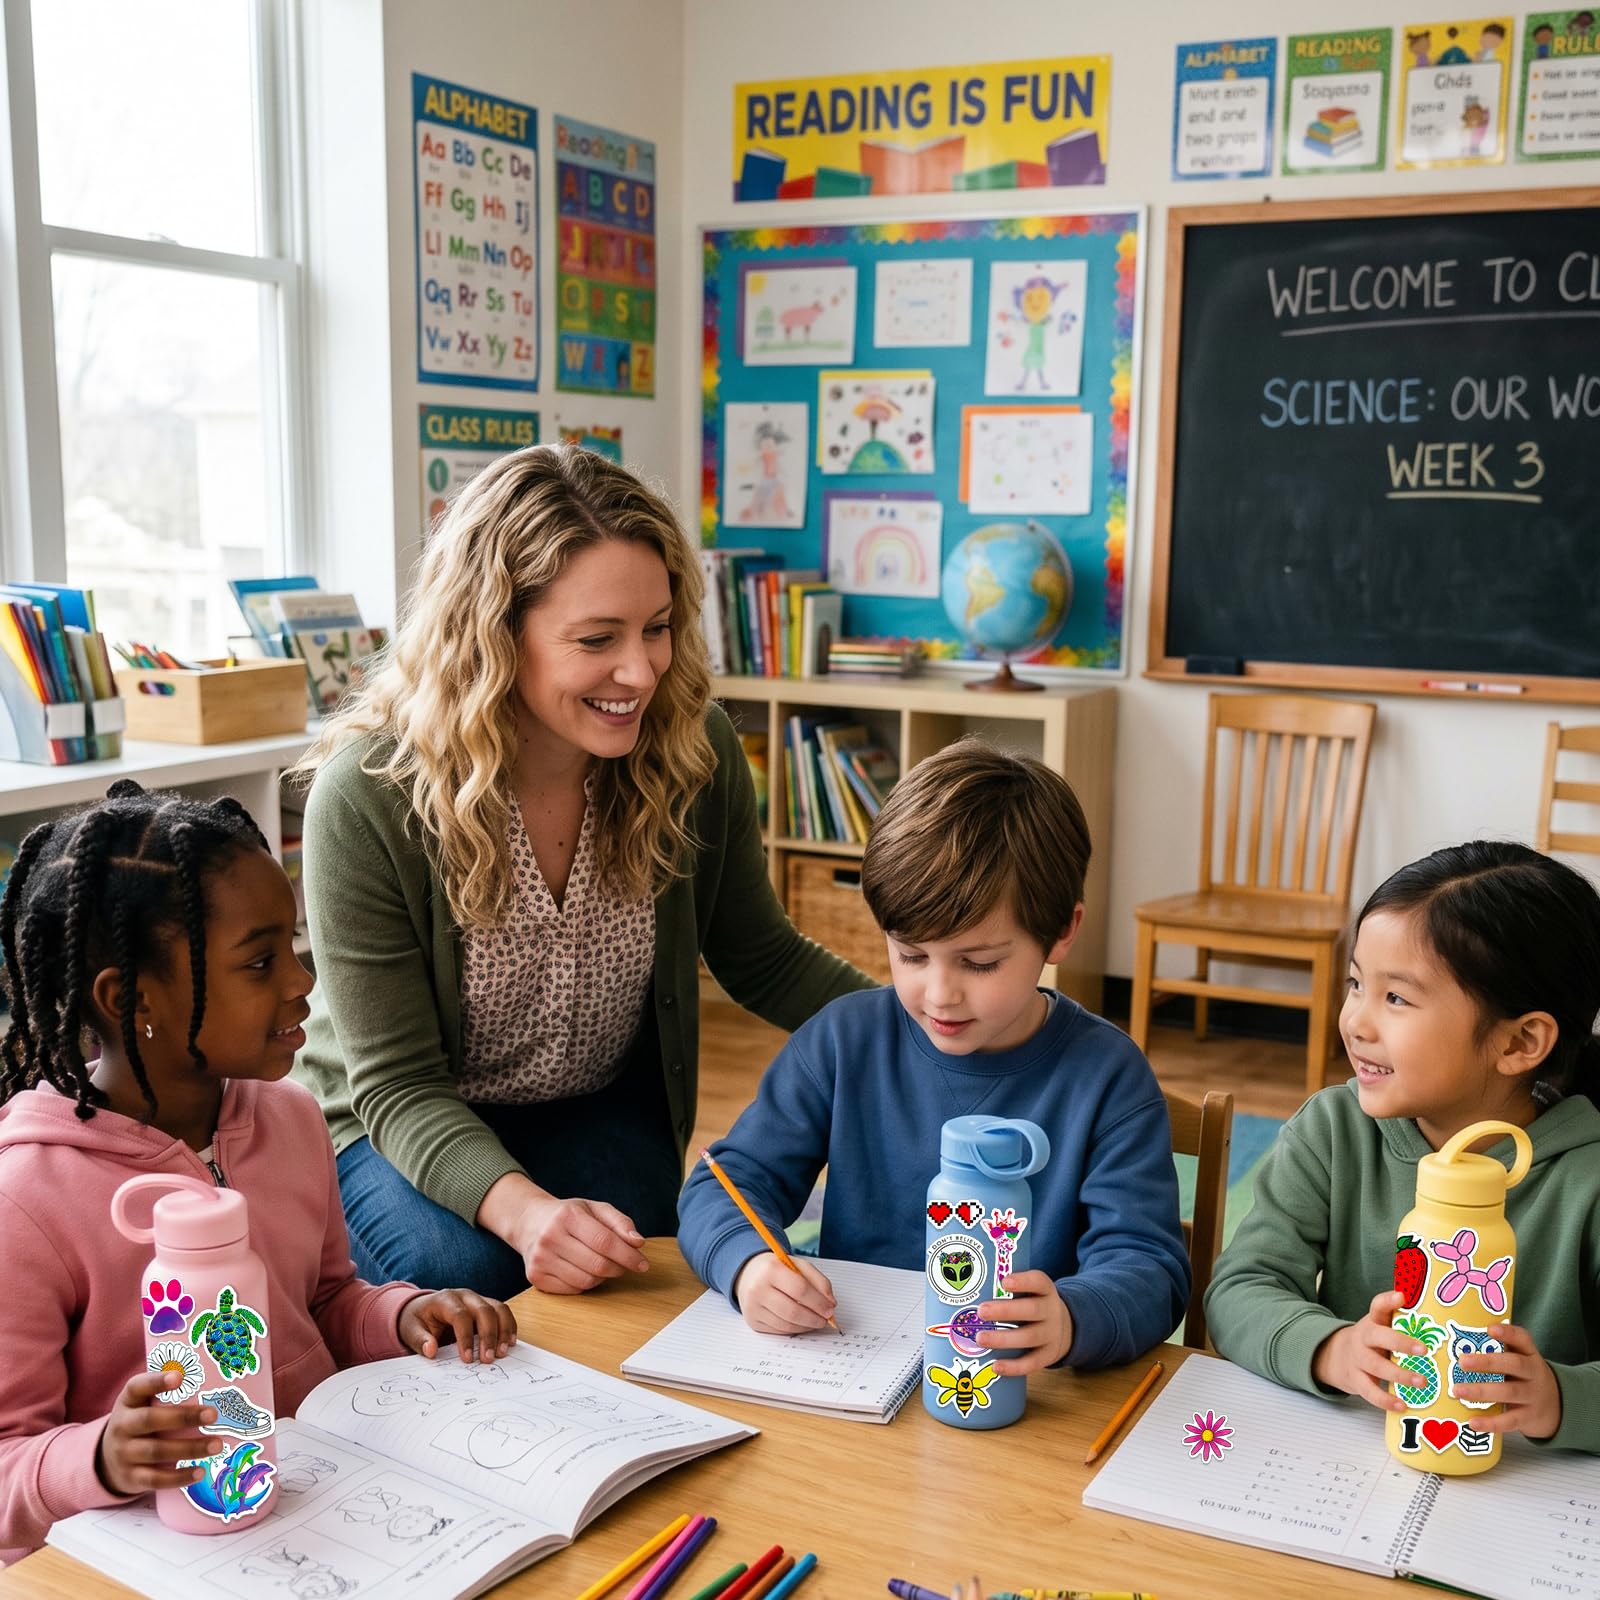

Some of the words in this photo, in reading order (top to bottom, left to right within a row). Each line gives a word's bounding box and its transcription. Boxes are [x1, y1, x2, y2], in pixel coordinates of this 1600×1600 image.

[1184, 46, 1270, 68] ALPHABET
[1296, 36, 1382, 57] READING
[424, 85, 528, 140] ALPHABET
[746, 81, 932, 140] READING
[949, 78, 986, 126] IS
[1003, 70, 1094, 123] FUN
[422, 133, 446, 160] Aa
[453, 139, 476, 167] Bb
[481, 147, 504, 175] Cc
[510, 154, 532, 181] De
[425, 181, 443, 208] Ff
[451, 187, 476, 222] Gg
[483, 194, 506, 222] Hh
[588, 174, 604, 207] B
[613, 181, 628, 214] C
[635, 184, 650, 218] D
[448, 234, 480, 262] Mm
[483, 240, 507, 267] Nn
[510, 245, 532, 273] Op
[425, 278, 452, 314] Qq
[458, 283, 478, 308] Rr
[486, 287, 505, 312] Ss
[512, 290, 532, 316] Tu
[1267, 260, 1459, 319] WELCOME
[1483, 257, 1537, 304] TO
[1558, 251, 1600, 302] CL
[614, 292, 629, 322] S
[425, 325, 451, 351] Vw
[457, 329, 480, 356] Xx
[486, 333, 508, 368] Yy
[513, 336, 532, 361] Zz
[563, 340, 587, 371] W
[1260, 377, 1436, 428] SCIENCE:
[1451, 376, 1530, 422] OUR
[1549, 374, 1600, 421] WO
[427, 414, 481, 442] CLASS
[485, 418, 534, 445] RULES
[1387, 441, 1496, 489] WEEK
[1512, 441, 1546, 490] 3
[932, 1236, 953, 1250] DON'T
[955, 1236, 982, 1250] BELIEVE
[950, 1292, 977, 1304] HUMANS
[1401, 1418, 1420, 1449] I
